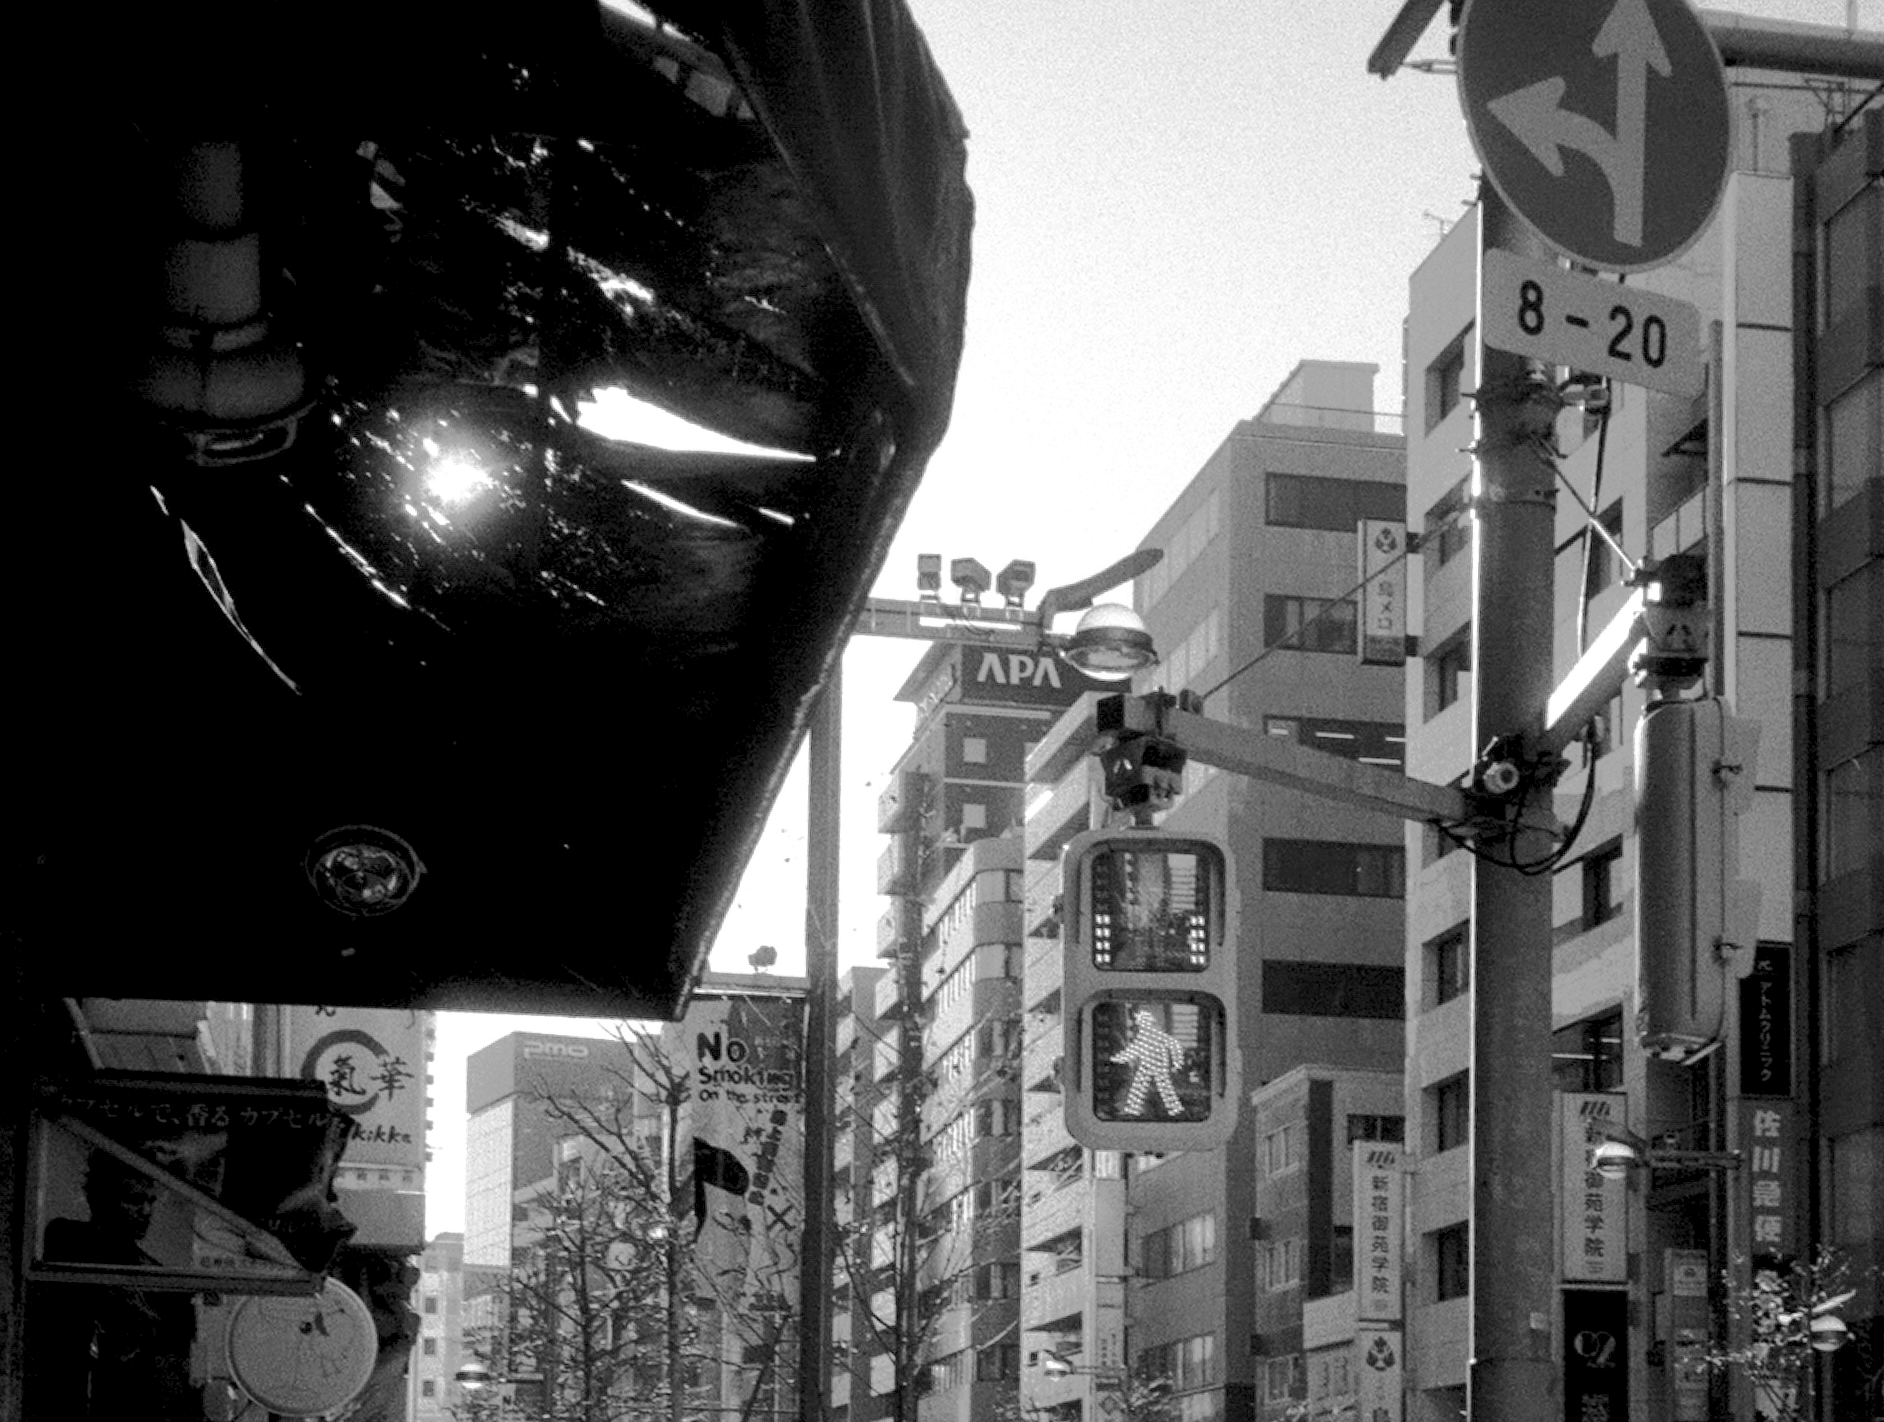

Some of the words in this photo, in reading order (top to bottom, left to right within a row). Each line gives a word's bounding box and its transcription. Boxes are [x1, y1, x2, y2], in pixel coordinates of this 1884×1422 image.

[1518, 279, 1667, 368] 8-20
[976, 651, 1062, 689] APA
[524, 1041, 588, 1060] pmo
[697, 1031, 747, 1063] No
[699, 1065, 796, 1093] Smoking
[1752, 1109, 1782, 1242] 佐川急便
[1371, 1175, 1389, 1294] 新宿御苑学院
